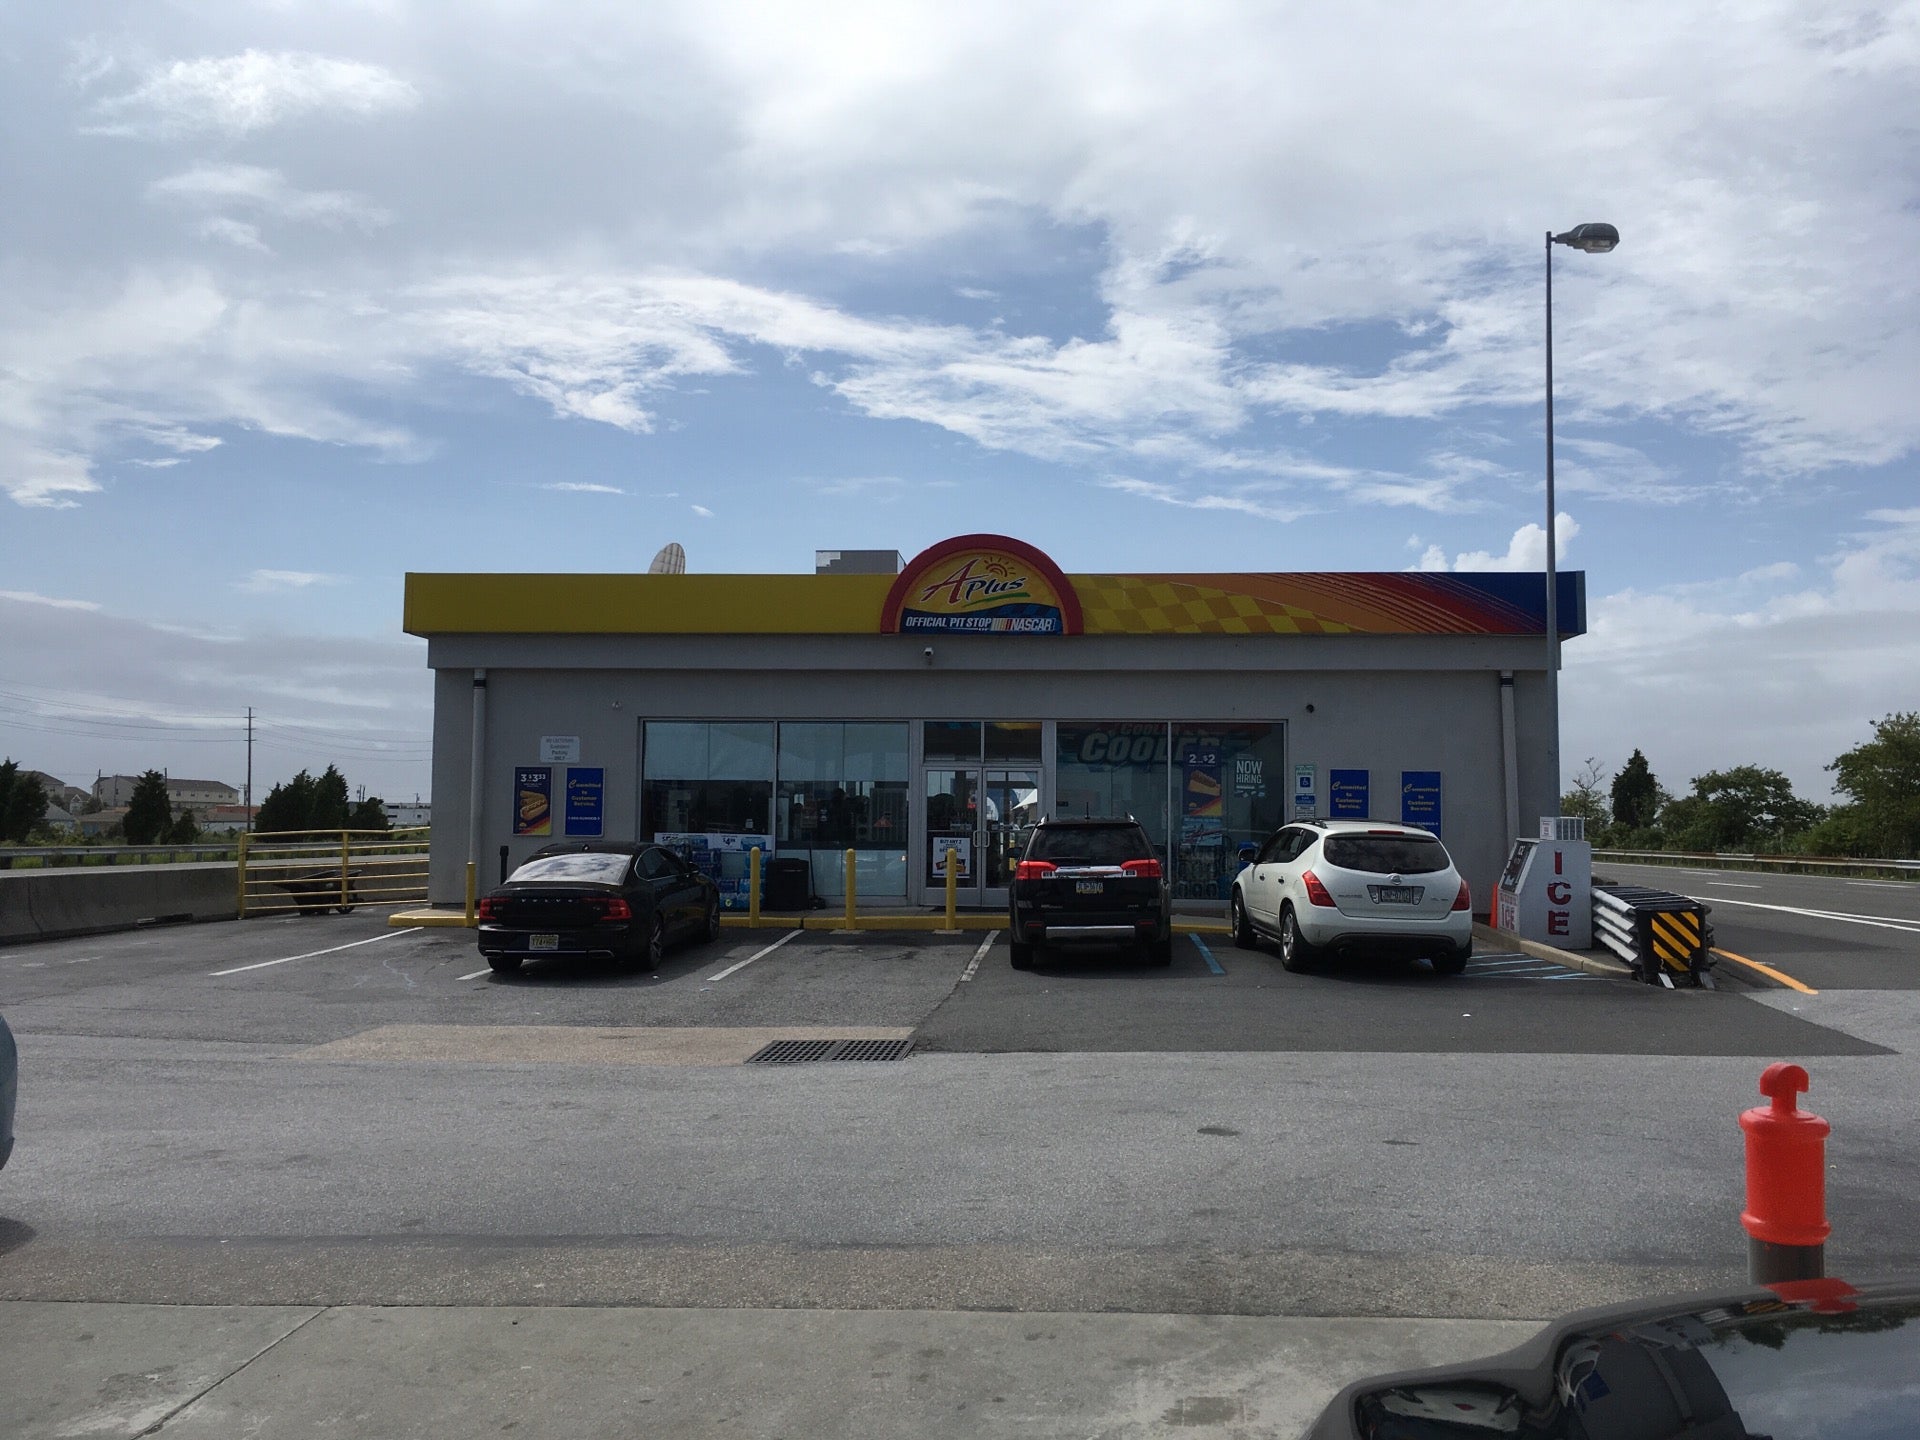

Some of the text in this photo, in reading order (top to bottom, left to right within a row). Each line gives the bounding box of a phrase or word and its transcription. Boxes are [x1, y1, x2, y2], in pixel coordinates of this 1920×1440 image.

[906, 616, 1054, 631] OFFICIAL PIT STOP NASCAR
[1188, 754, 1197, 764] 2
[1236, 760, 1263, 774] NOW
[1236, 774, 1262, 784] HIRING
[1547, 851, 1571, 936] ICE
